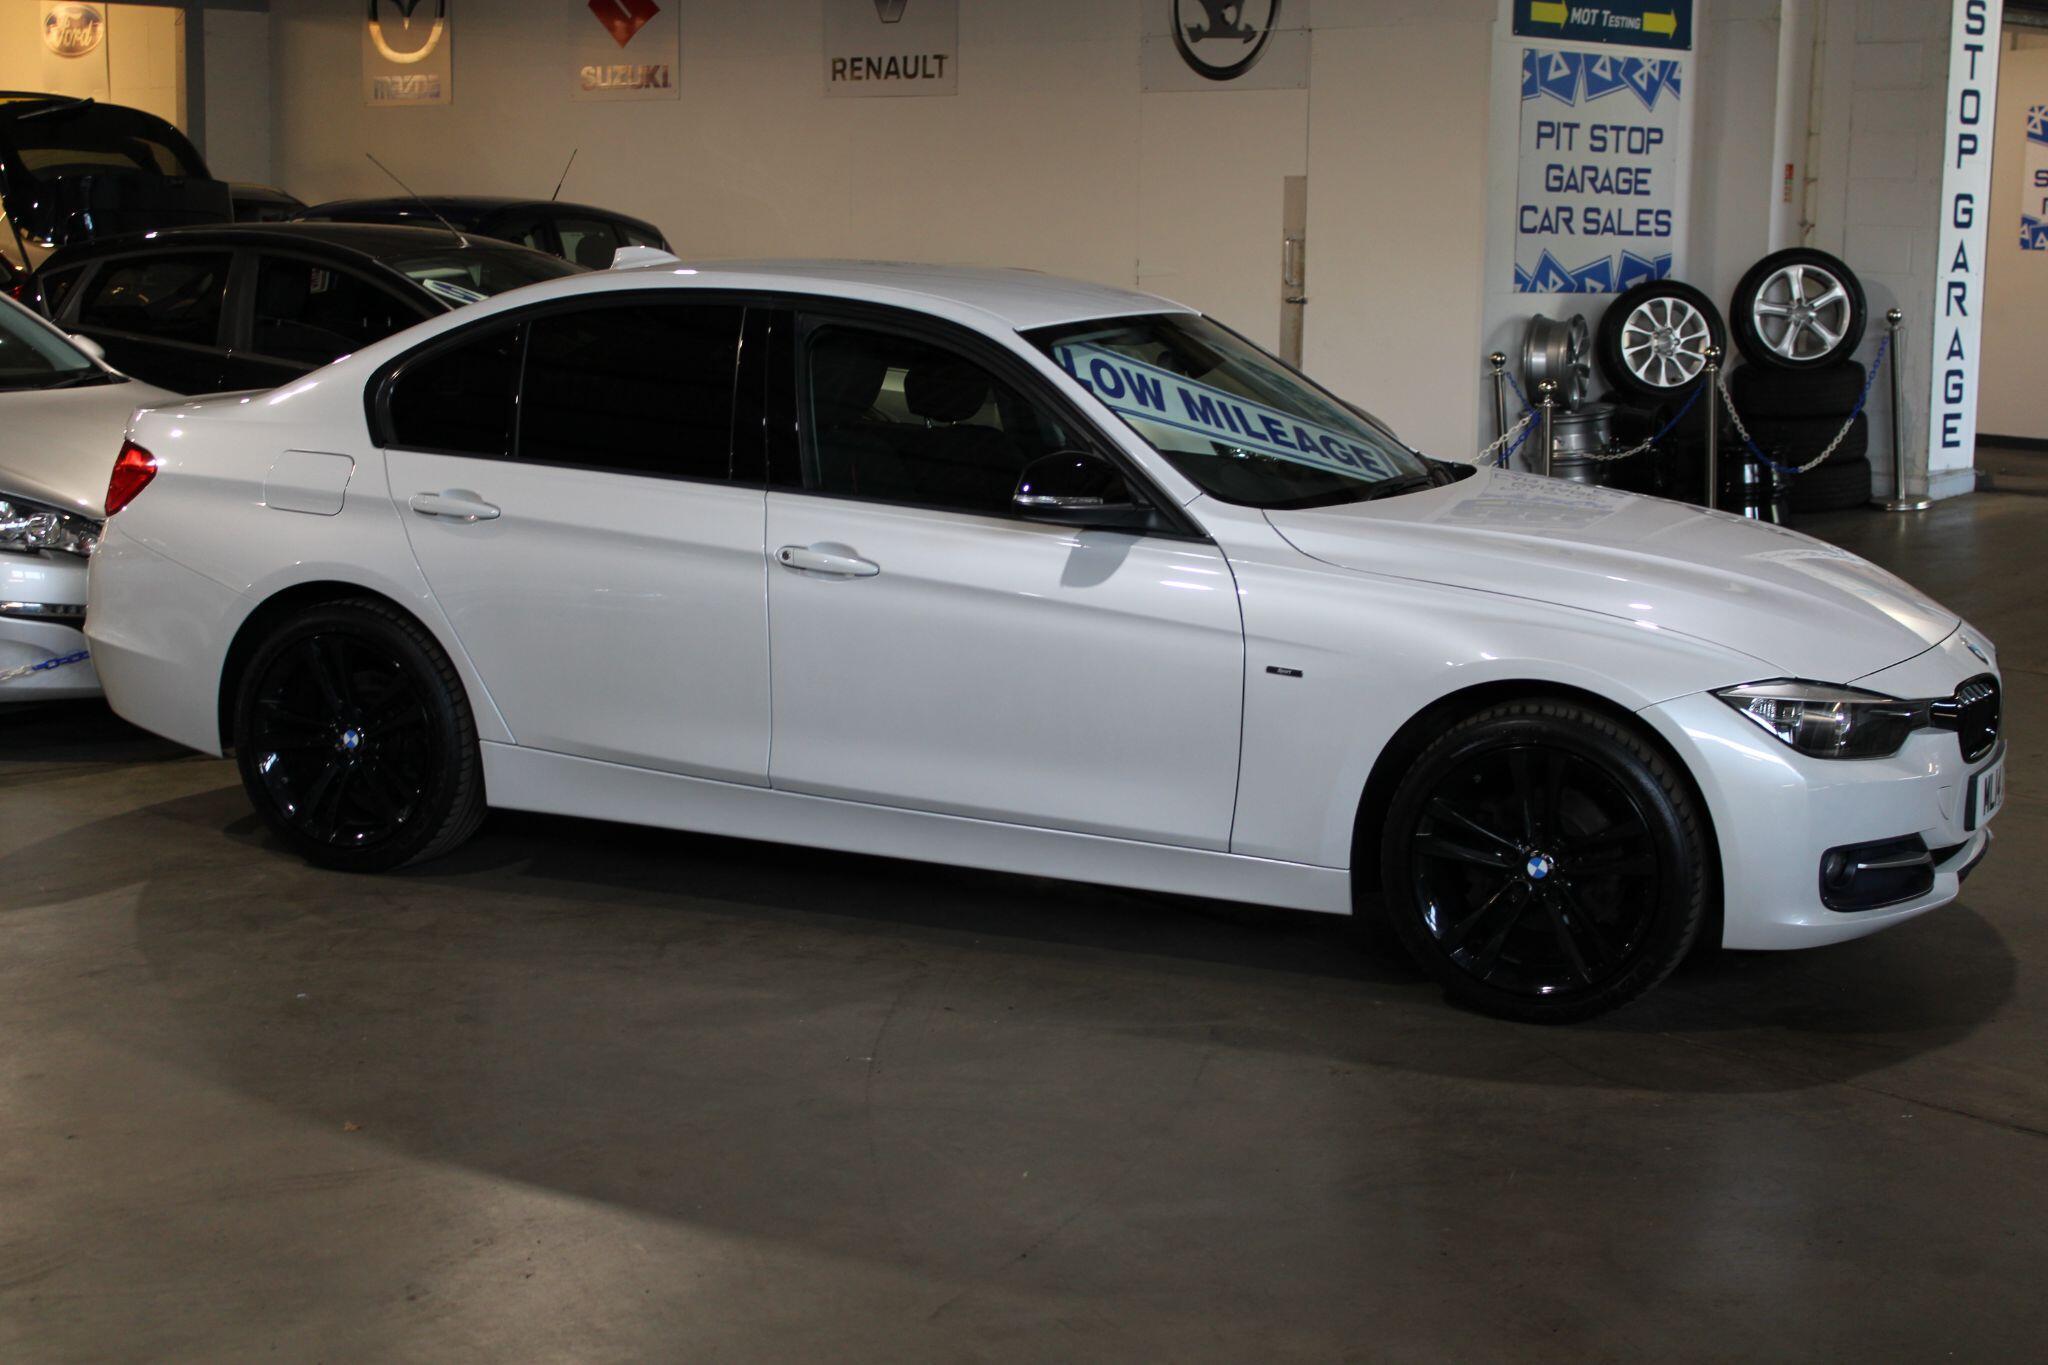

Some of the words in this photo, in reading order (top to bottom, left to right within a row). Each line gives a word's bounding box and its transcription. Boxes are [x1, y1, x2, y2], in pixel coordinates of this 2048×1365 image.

[1570, 7, 1600, 26] MOT
[580, 64, 671, 91] SUZUKI
[831, 54, 949, 82] RENAULT
[1956, 0, 1987, 170] STOP
[1536, 120, 1581, 151] PIT
[1589, 123, 1664, 155] STOP
[1545, 163, 1653, 196] GARAGE
[1519, 204, 1576, 236] CAR
[1582, 206, 1672, 237] SALES
[1941, 193, 1974, 448] GARAGE
[1056, 345, 1167, 413] LOW
[1176, 386, 1391, 479] MILEAGE
